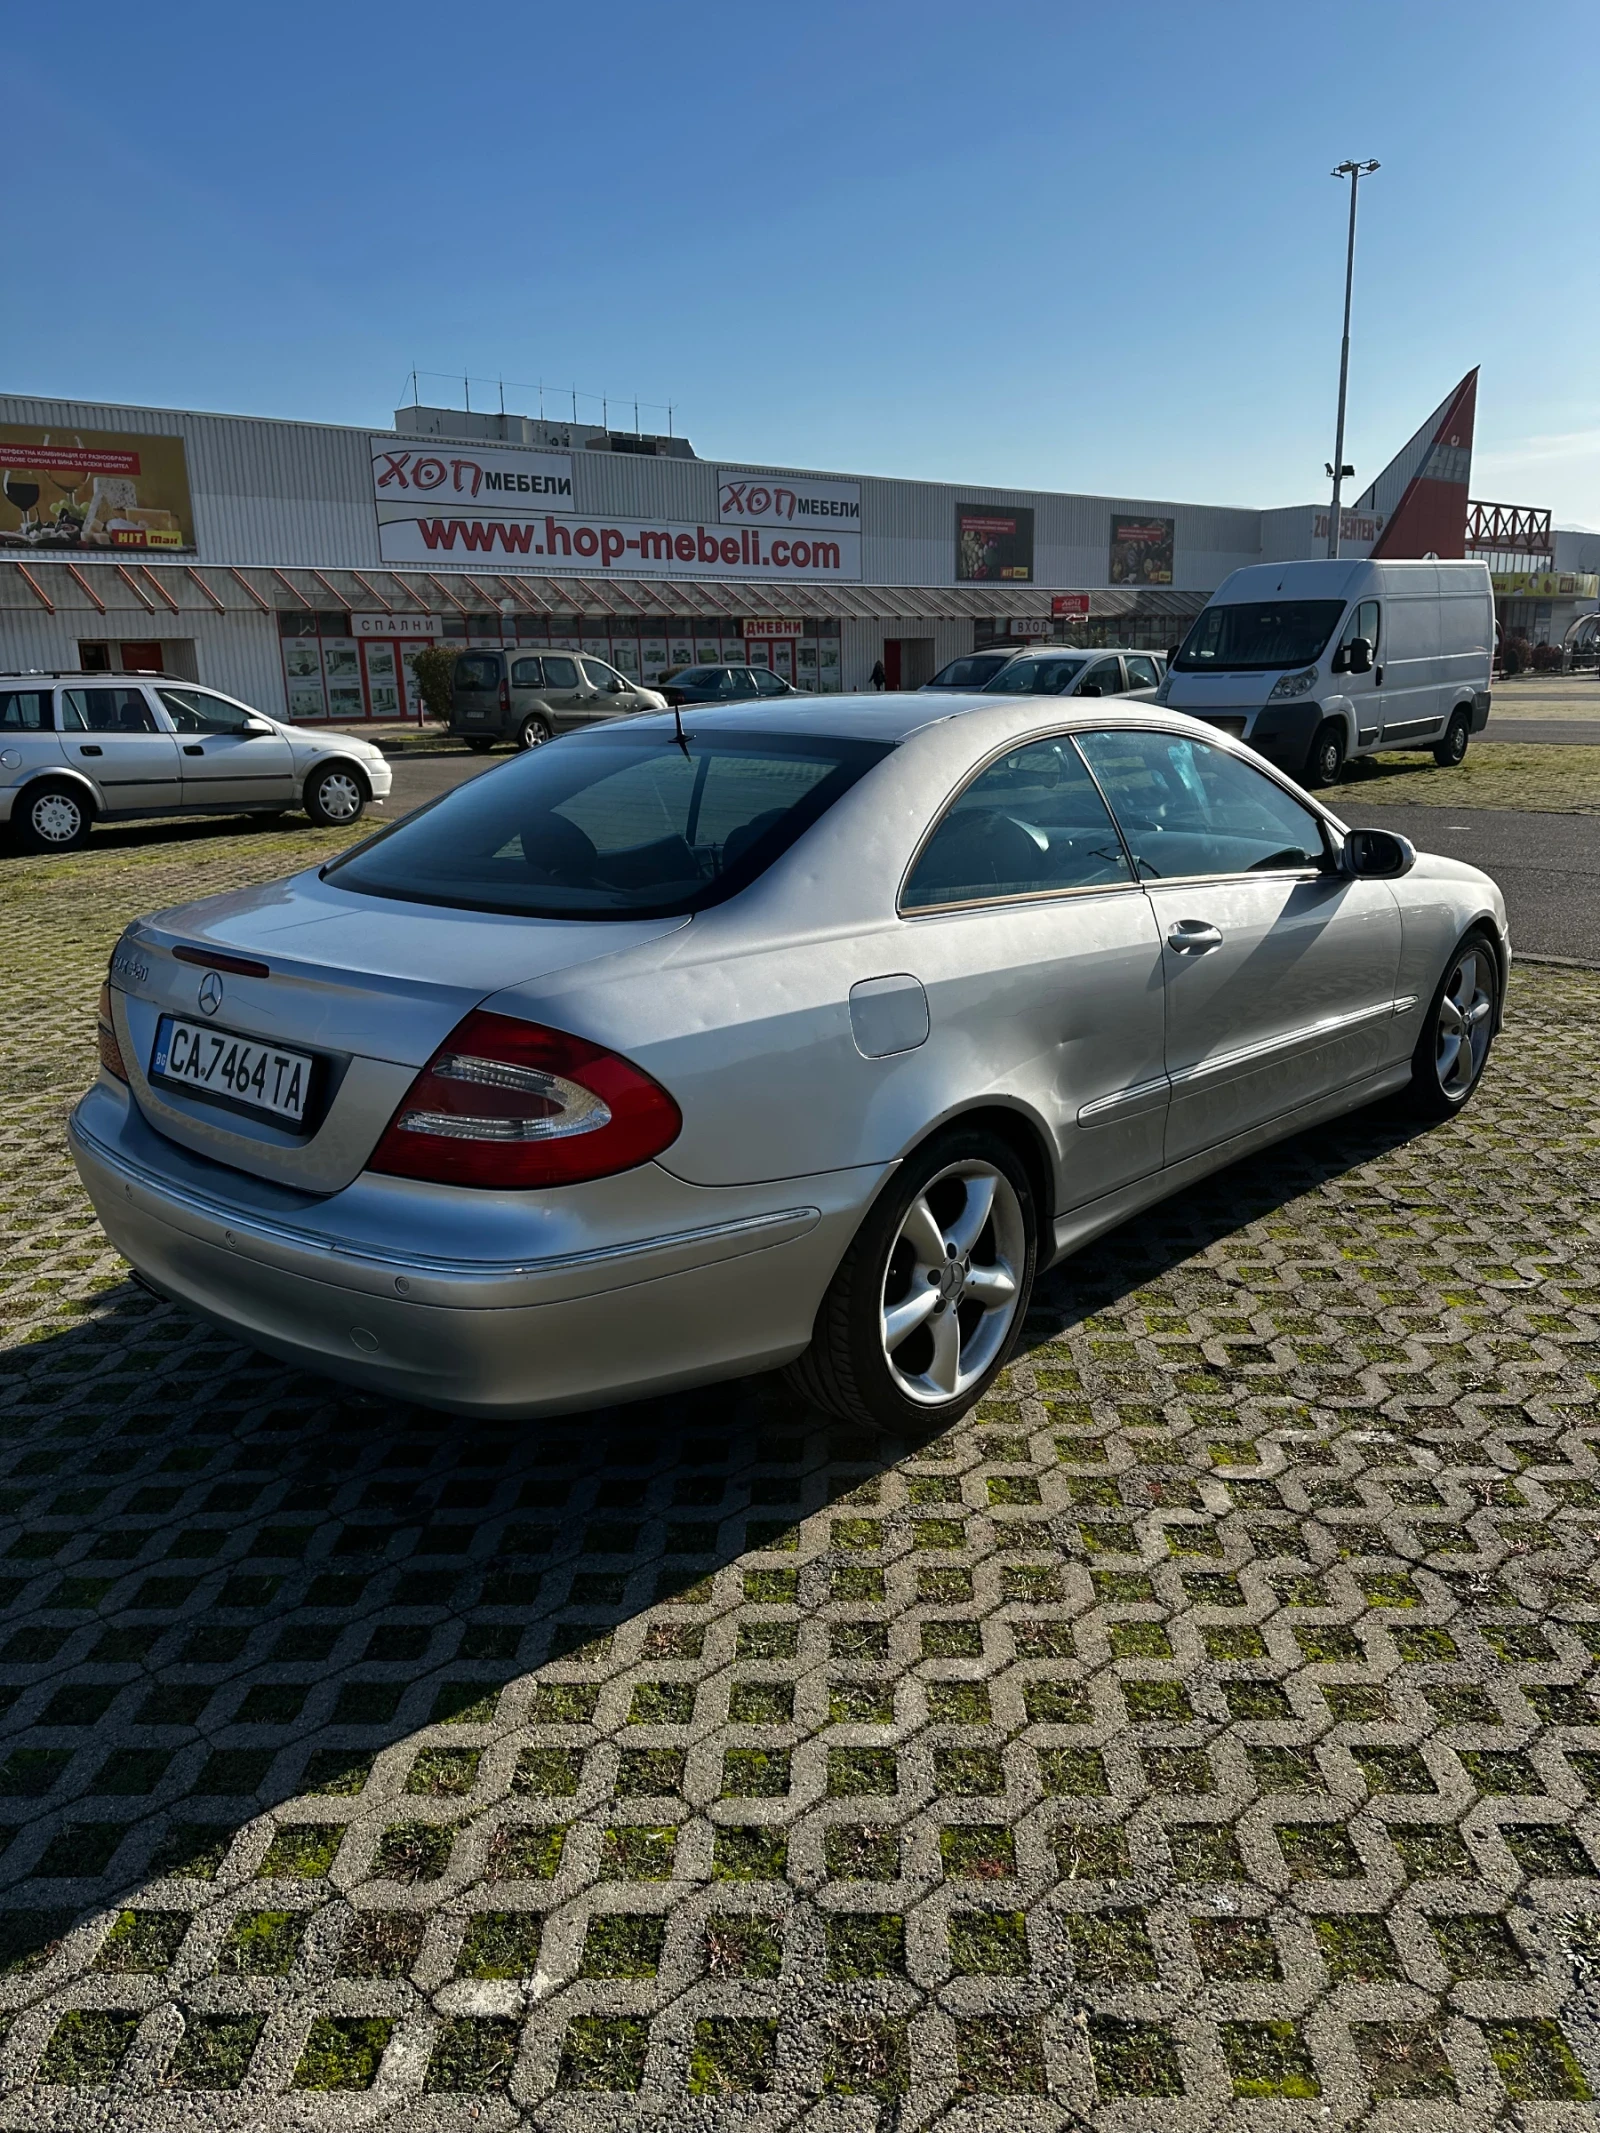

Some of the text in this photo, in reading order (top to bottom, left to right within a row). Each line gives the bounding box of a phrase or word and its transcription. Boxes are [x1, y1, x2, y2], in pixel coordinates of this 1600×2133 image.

[37, 450, 79, 459] КОМБИНАЦИЯ
[88, 454, 133, 462] РАЗНООБРАЗНИ
[377, 452, 572, 497] ХОП МЕБЕЛИ
[721, 483, 860, 521] ХОП МЕБЕЛИ
[118, 532, 143, 543] HIT
[417, 516, 840, 569] www.hop-mebeli.com
[361, 619, 434, 632] СПАЛНИ
[746, 621, 801, 636] ДНЕВНИ
[1017, 621, 1047, 633] ВХОД
[156, 1052, 167, 1066] BG
